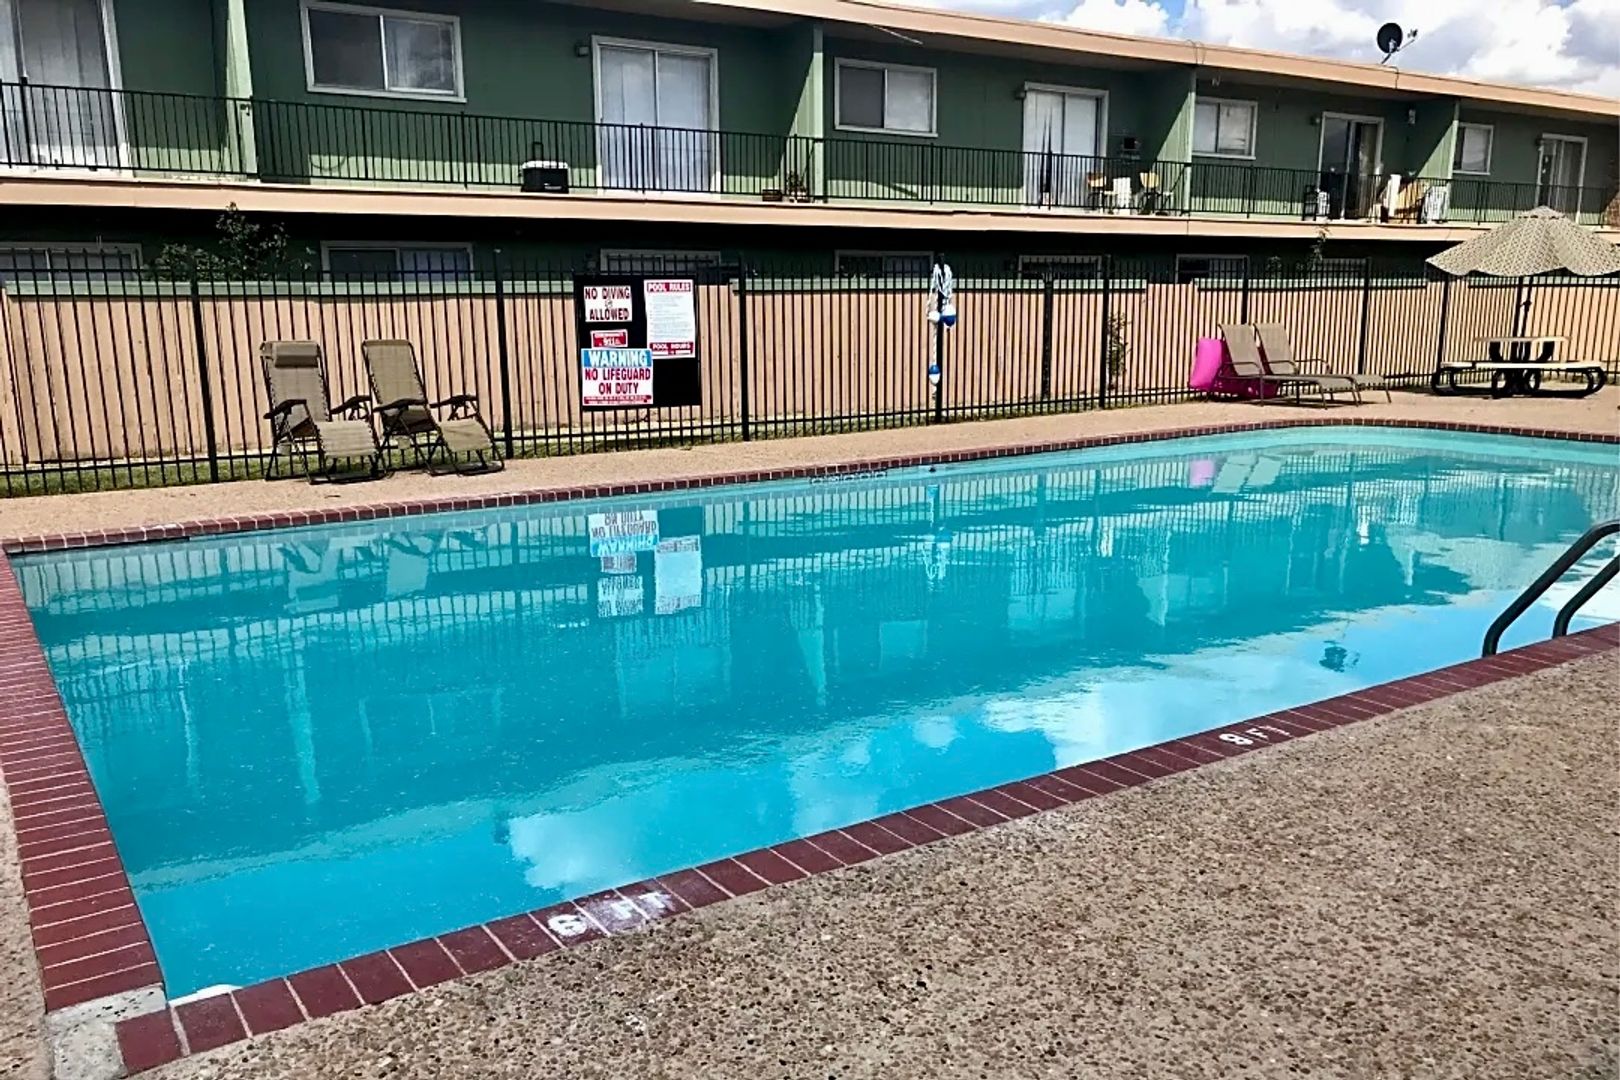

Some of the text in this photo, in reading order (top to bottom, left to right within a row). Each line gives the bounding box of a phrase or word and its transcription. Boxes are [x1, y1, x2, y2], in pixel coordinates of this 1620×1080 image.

[585, 286, 631, 300] NO DIVING
[648, 282, 690, 291] POOL RULES
[589, 308, 630, 321] ALLOWED
[588, 349, 648, 368] WARNING
[585, 367, 651, 381] NO LIFEGUARD
[598, 382, 639, 395] ON DUTY
[1218, 732, 1254, 746] 8
